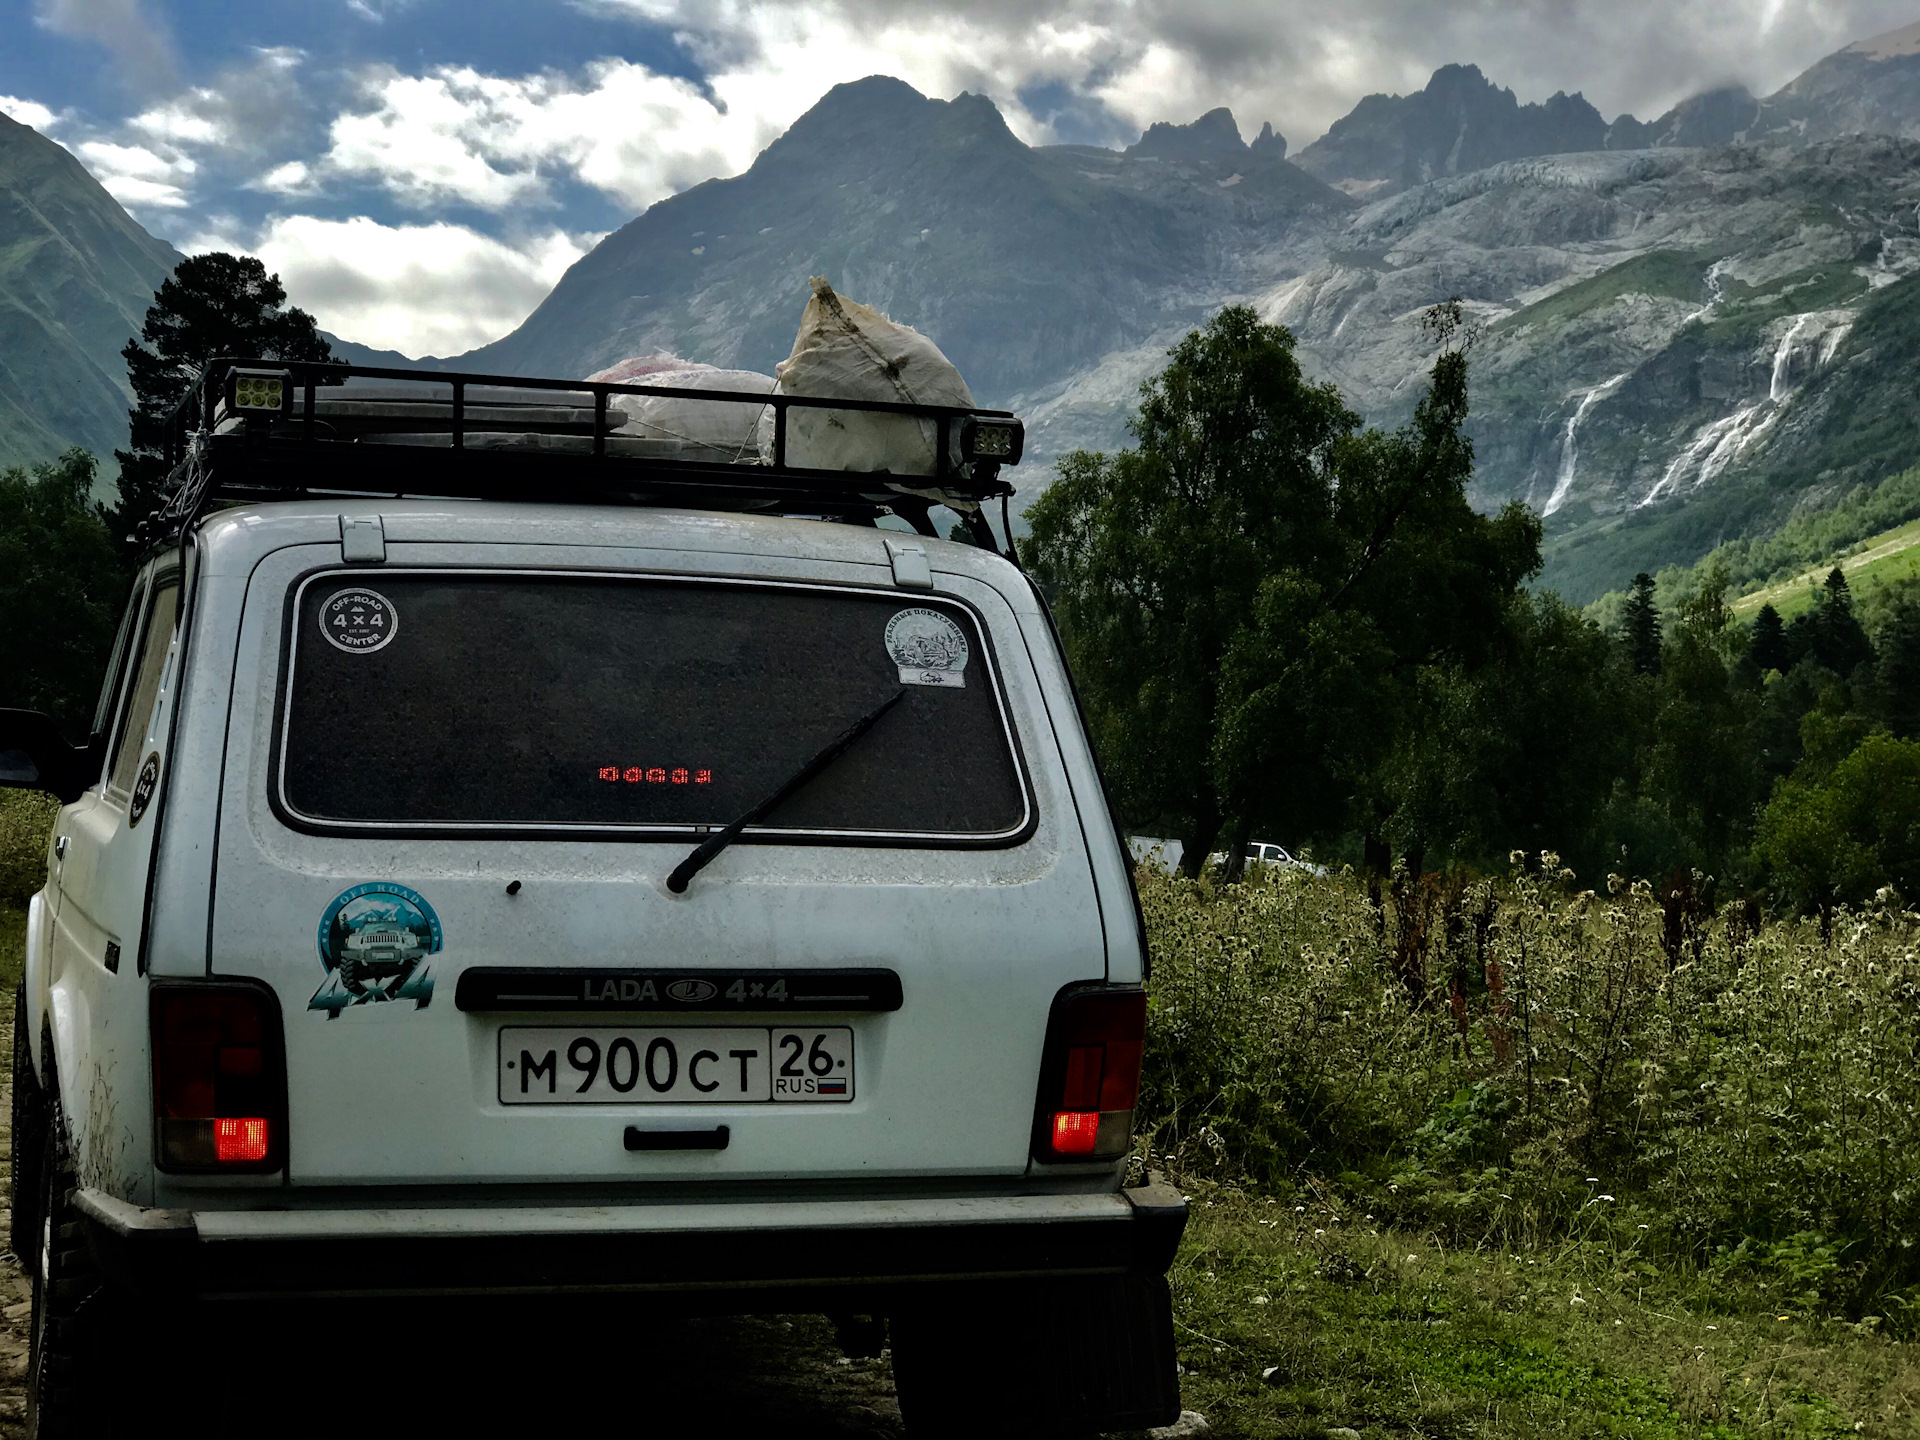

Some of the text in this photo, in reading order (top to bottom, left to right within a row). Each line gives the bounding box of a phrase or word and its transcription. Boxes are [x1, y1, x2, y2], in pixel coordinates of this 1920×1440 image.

[331, 595, 383, 611] OFF-ROAD
[886, 610, 912, 643] РЕАЛЬНЫЕ
[339, 633, 381, 646] CENTER
[339, 884, 420, 905] OFF ROAD
[584, 979, 659, 1002] LADA
[779, 1033, 834, 1077] 26
[775, 1078, 816, 1094] RUS
